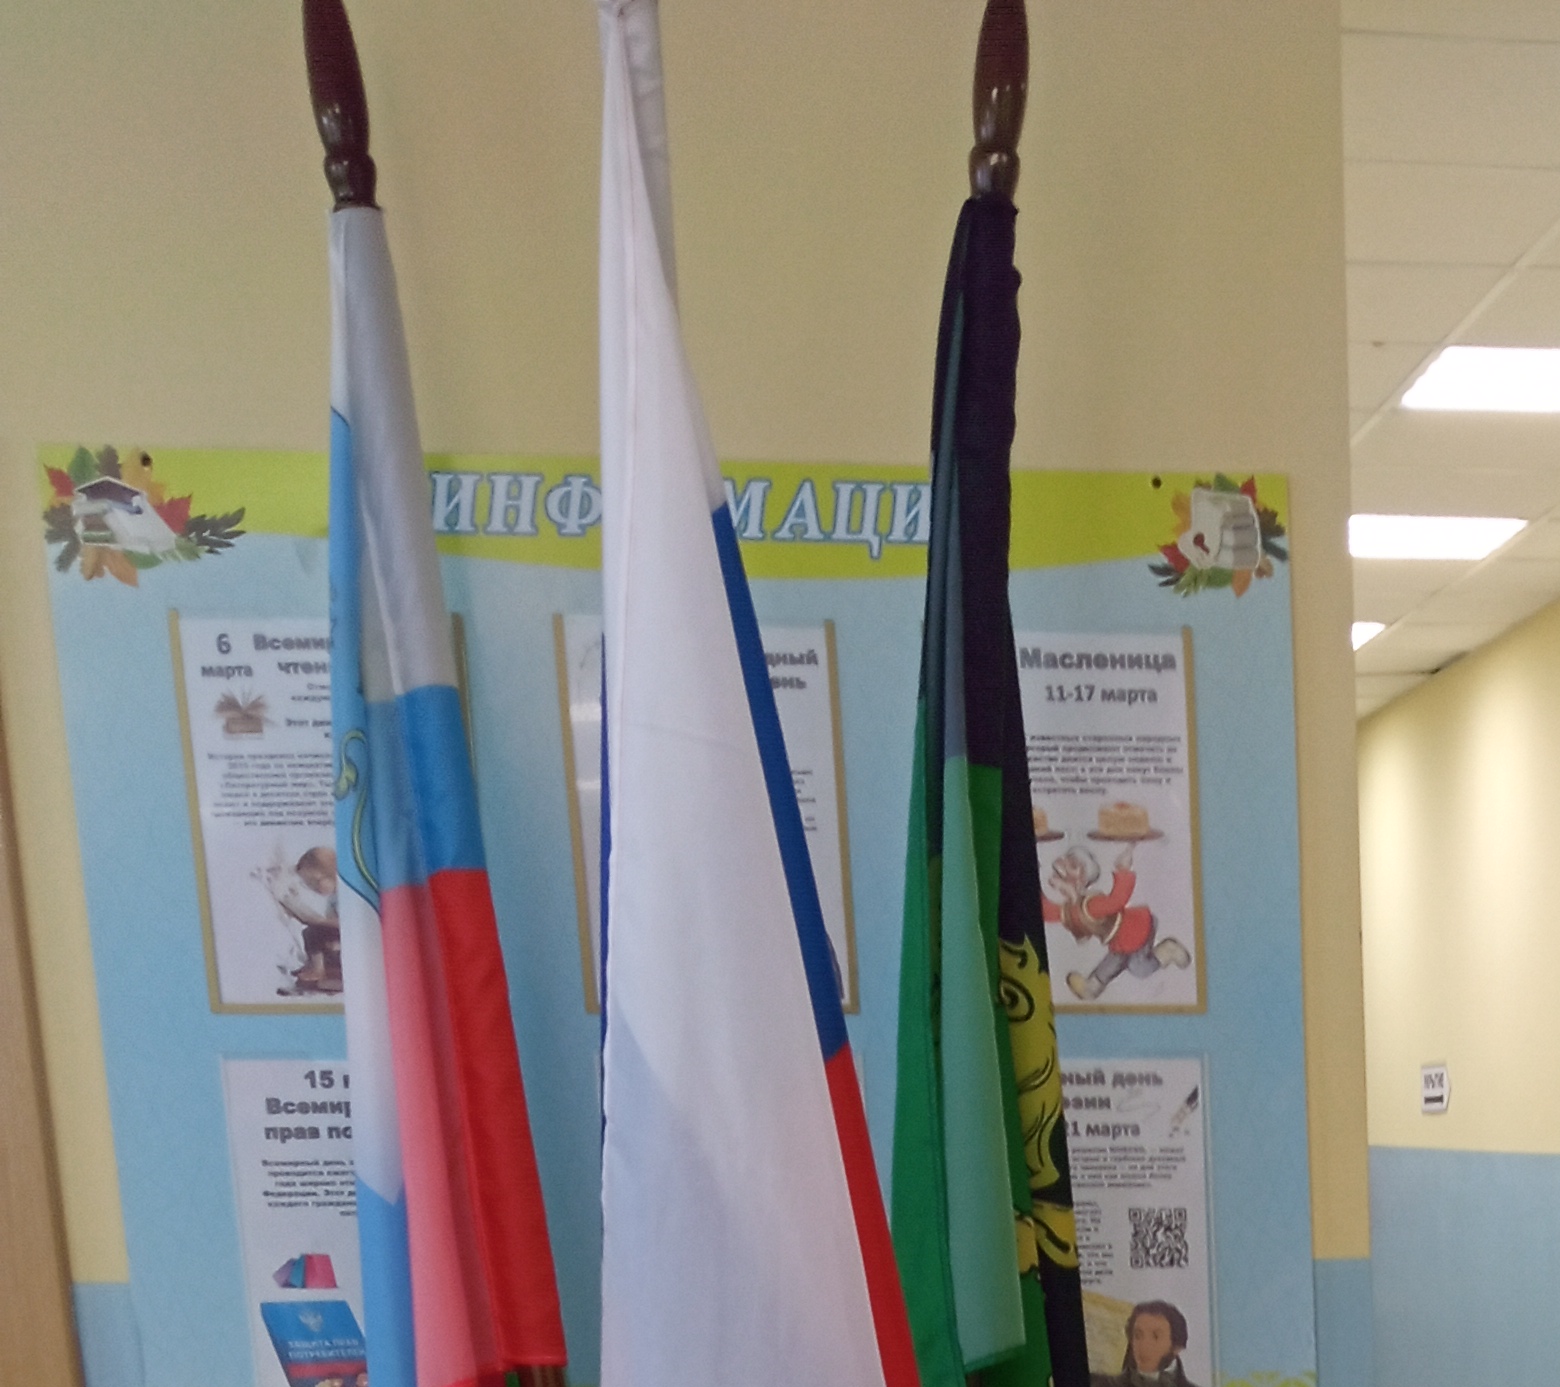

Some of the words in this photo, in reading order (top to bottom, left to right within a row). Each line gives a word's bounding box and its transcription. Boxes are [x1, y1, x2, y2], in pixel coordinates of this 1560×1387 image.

[216, 633, 231, 655] 6
[1018, 647, 1177, 673] Масленица
[201, 665, 254, 680] марта
[1045, 685, 1095, 702] 11-17
[1101, 688, 1158, 706] марта
[304, 1070, 335, 1088] 15
[1112, 1071, 1163, 1089] день
[264, 1126, 320, 1143] прав
[1086, 1123, 1141, 1141] марта
